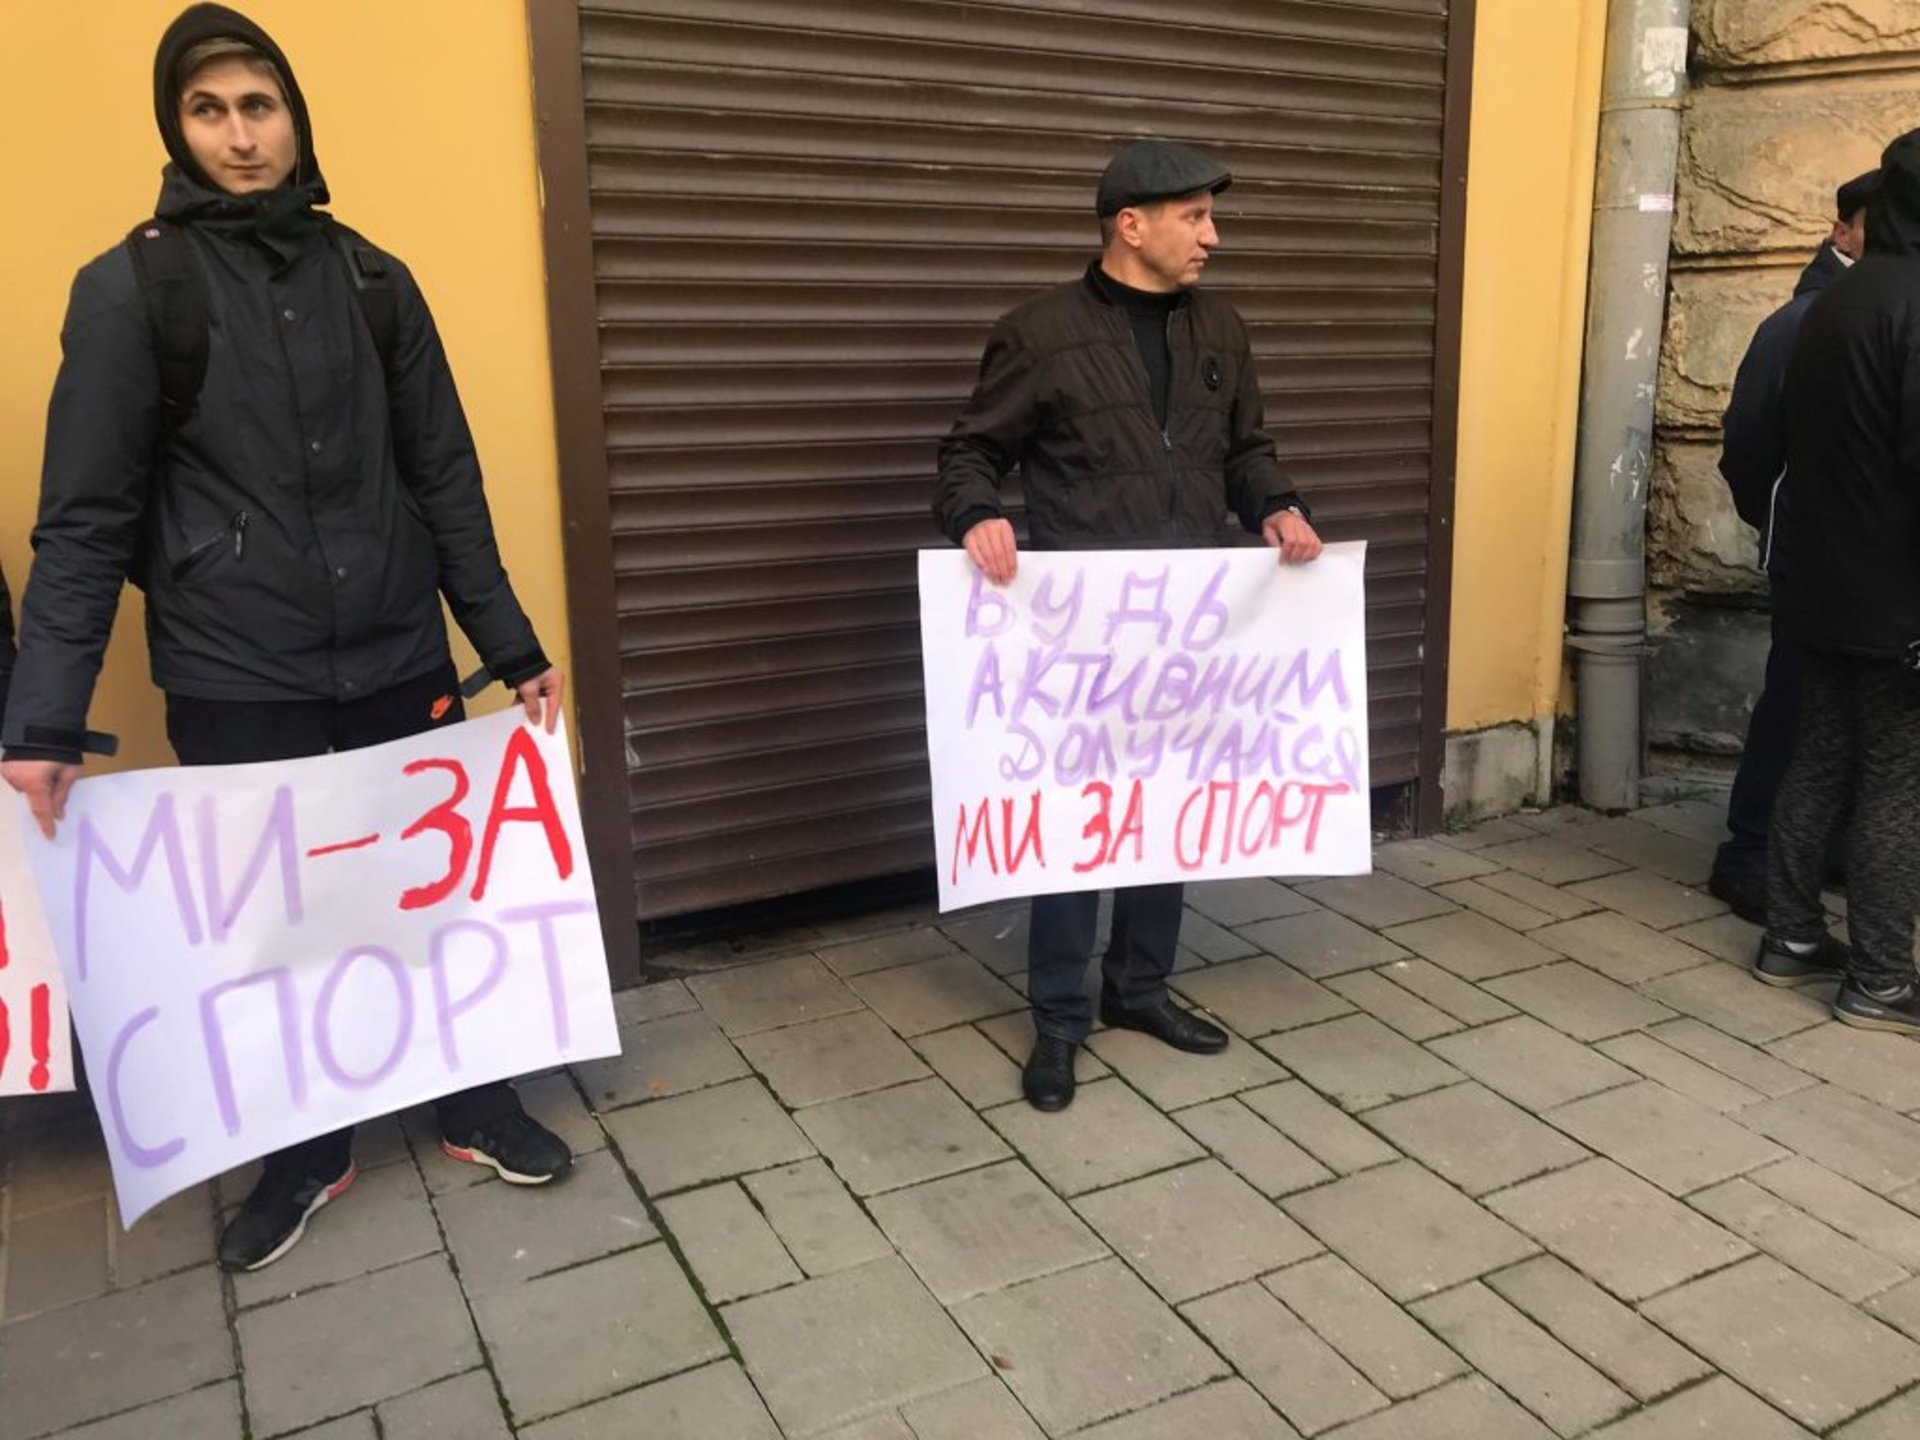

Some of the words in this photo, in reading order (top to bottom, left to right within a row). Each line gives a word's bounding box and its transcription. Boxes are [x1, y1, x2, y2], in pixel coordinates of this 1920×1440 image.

[965, 560, 1230, 652] БУДЬ
[965, 640, 1352, 729] АКТИВНИМ
[999, 710, 1362, 793] ДОЛУЧАЙСЯ
[952, 789, 1046, 886] МИ
[1073, 778, 1144, 873] ЗА
[1173, 779, 1351, 872] СПОРТ
[106, 900, 596, 1168] СПОРТ
